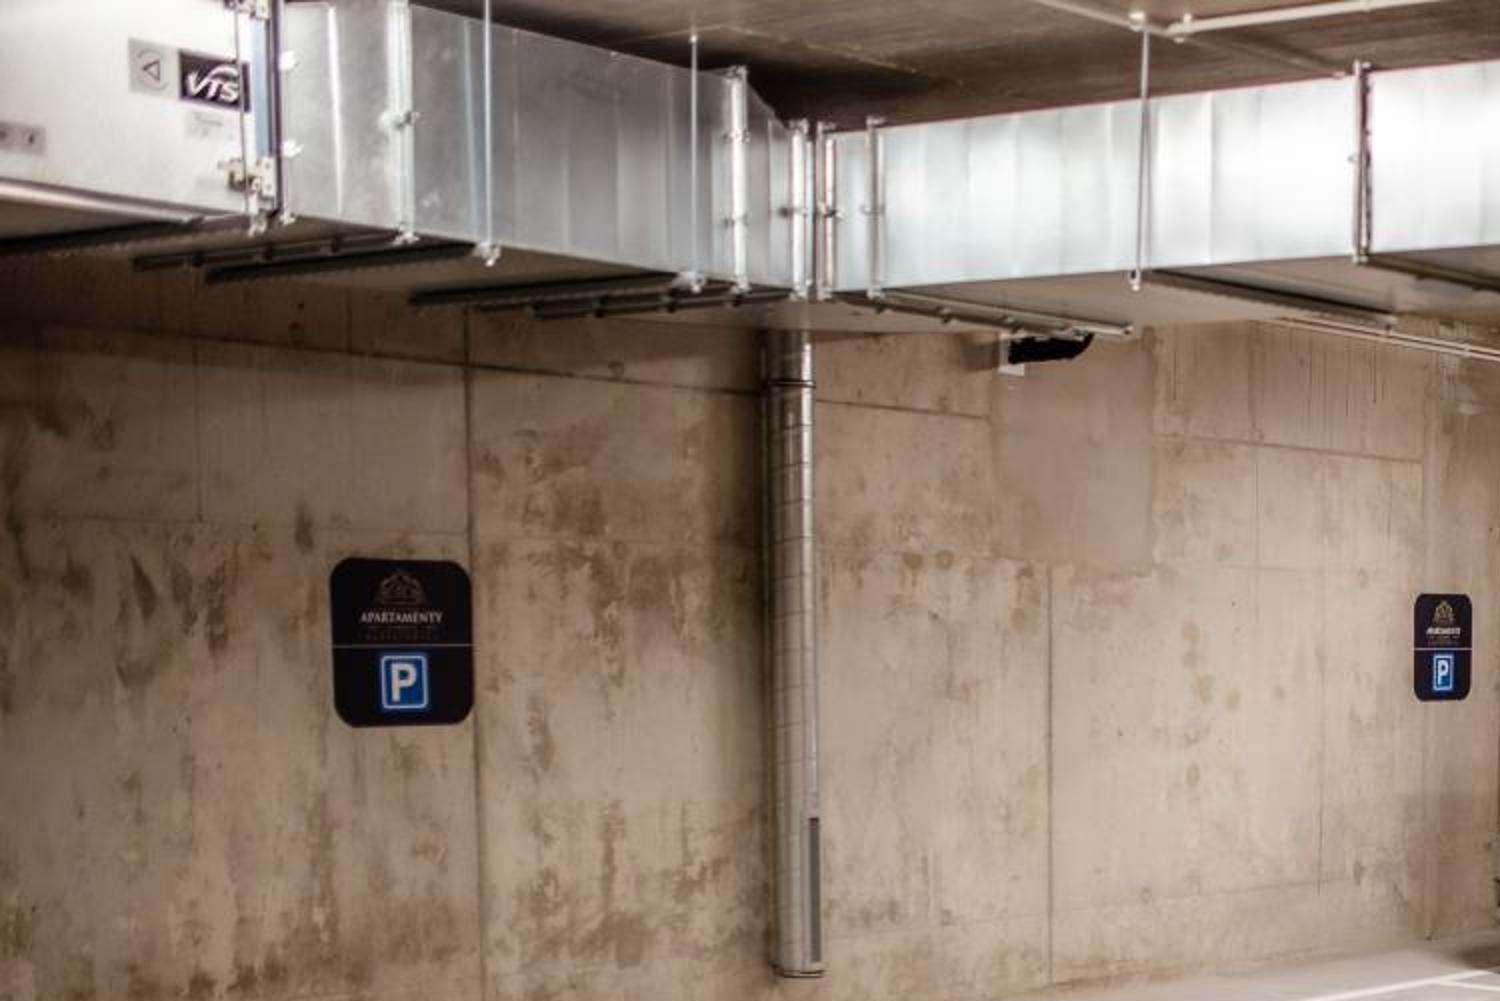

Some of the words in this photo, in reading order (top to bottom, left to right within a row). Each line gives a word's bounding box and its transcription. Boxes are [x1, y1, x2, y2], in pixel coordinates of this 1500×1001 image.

[186, 66, 240, 102] VTS
[359, 611, 444, 624] APARTAMENTY
[391, 662, 417, 702] P
[1438, 660, 1449, 685] P
